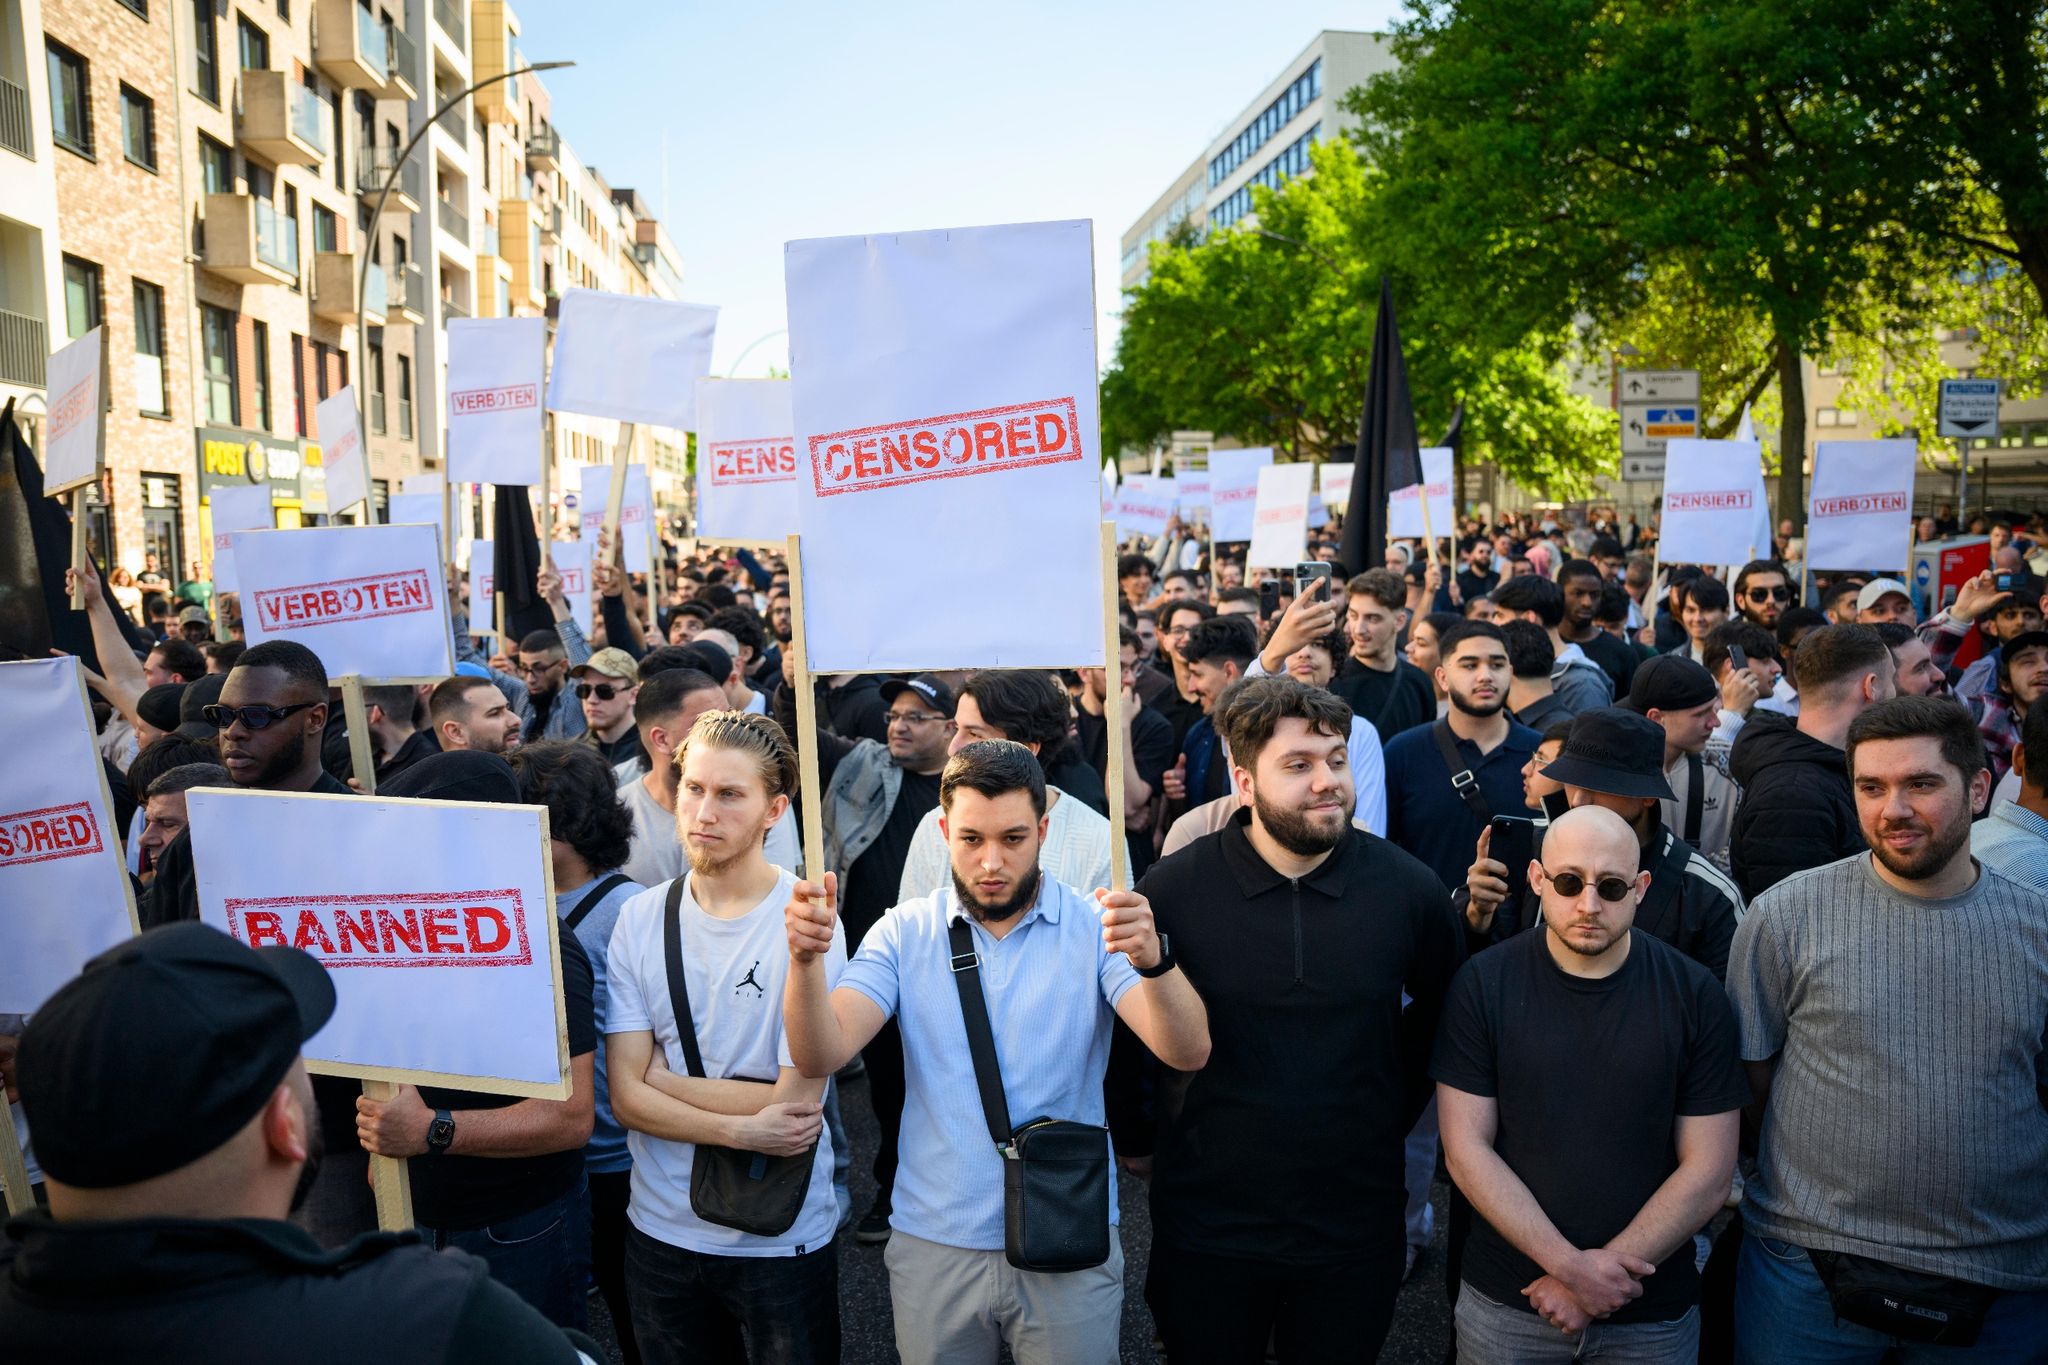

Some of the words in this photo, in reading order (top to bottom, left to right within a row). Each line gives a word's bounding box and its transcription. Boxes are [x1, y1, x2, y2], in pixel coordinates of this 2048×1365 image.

[456, 388, 533, 410] VERBOTEN
[204, 439, 246, 476] POST
[824, 413, 1067, 482] CENSORED
[1671, 493, 1746, 509] ZENSIERT
[1819, 496, 1901, 513] VERBOTEN
[264, 578, 423, 623] VERBOTEN
[244, 906, 511, 954] BANNED
[1884, 1299, 1899, 1309] THE
